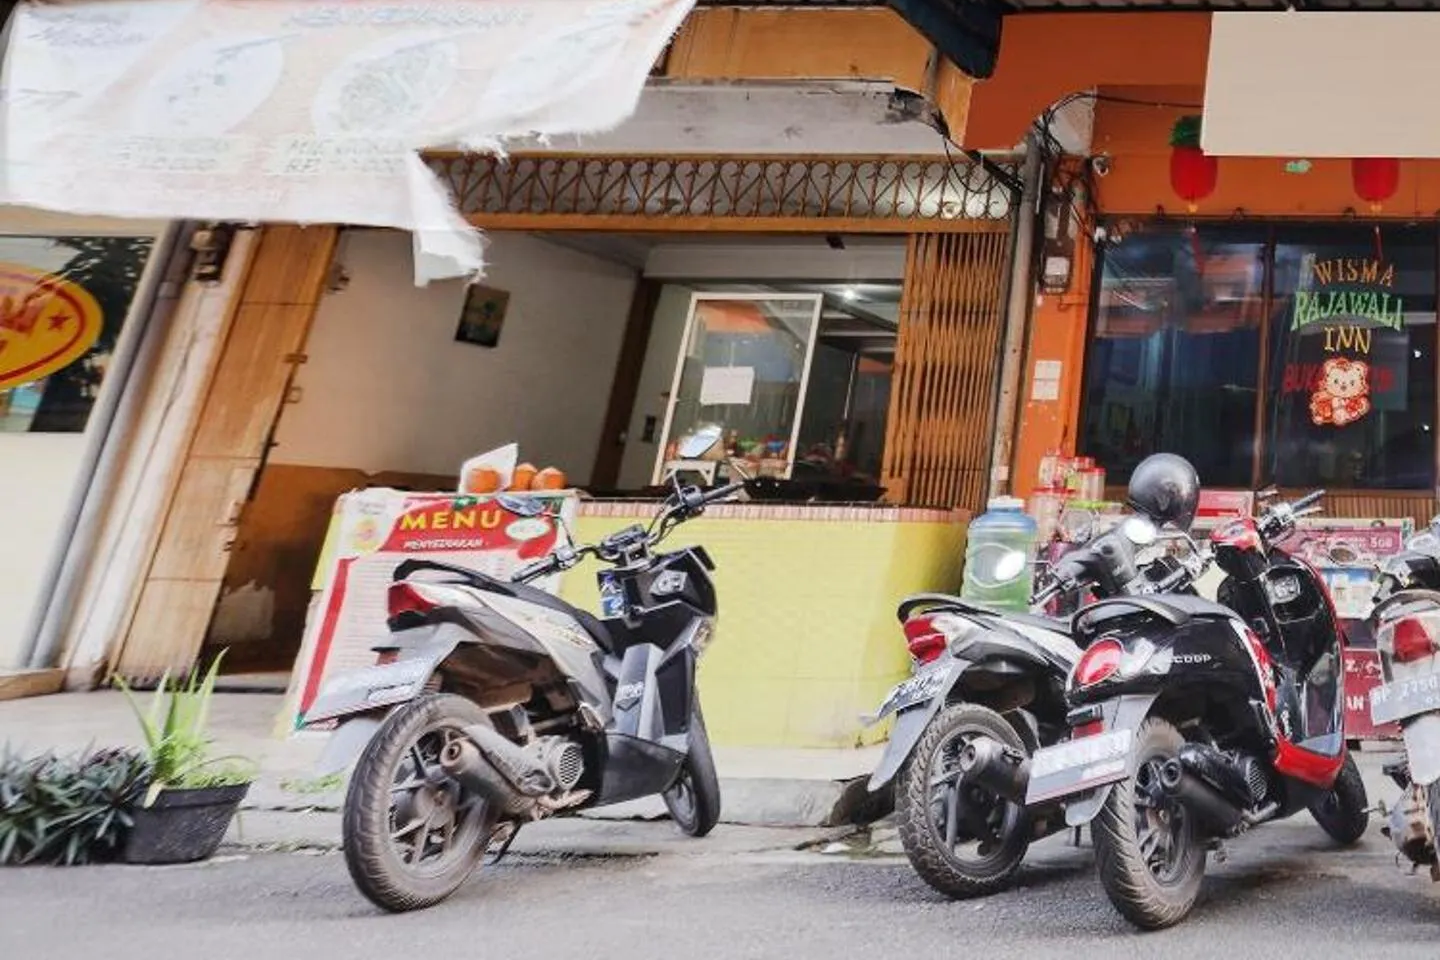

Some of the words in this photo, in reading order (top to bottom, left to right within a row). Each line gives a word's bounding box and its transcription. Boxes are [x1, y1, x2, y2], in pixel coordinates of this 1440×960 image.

[1313, 258, 1394, 288] WISMA
[1290, 290, 1404, 332] RAJAWALI
[1323, 325, 1372, 354] INN
[400, 509, 502, 531] MENU
